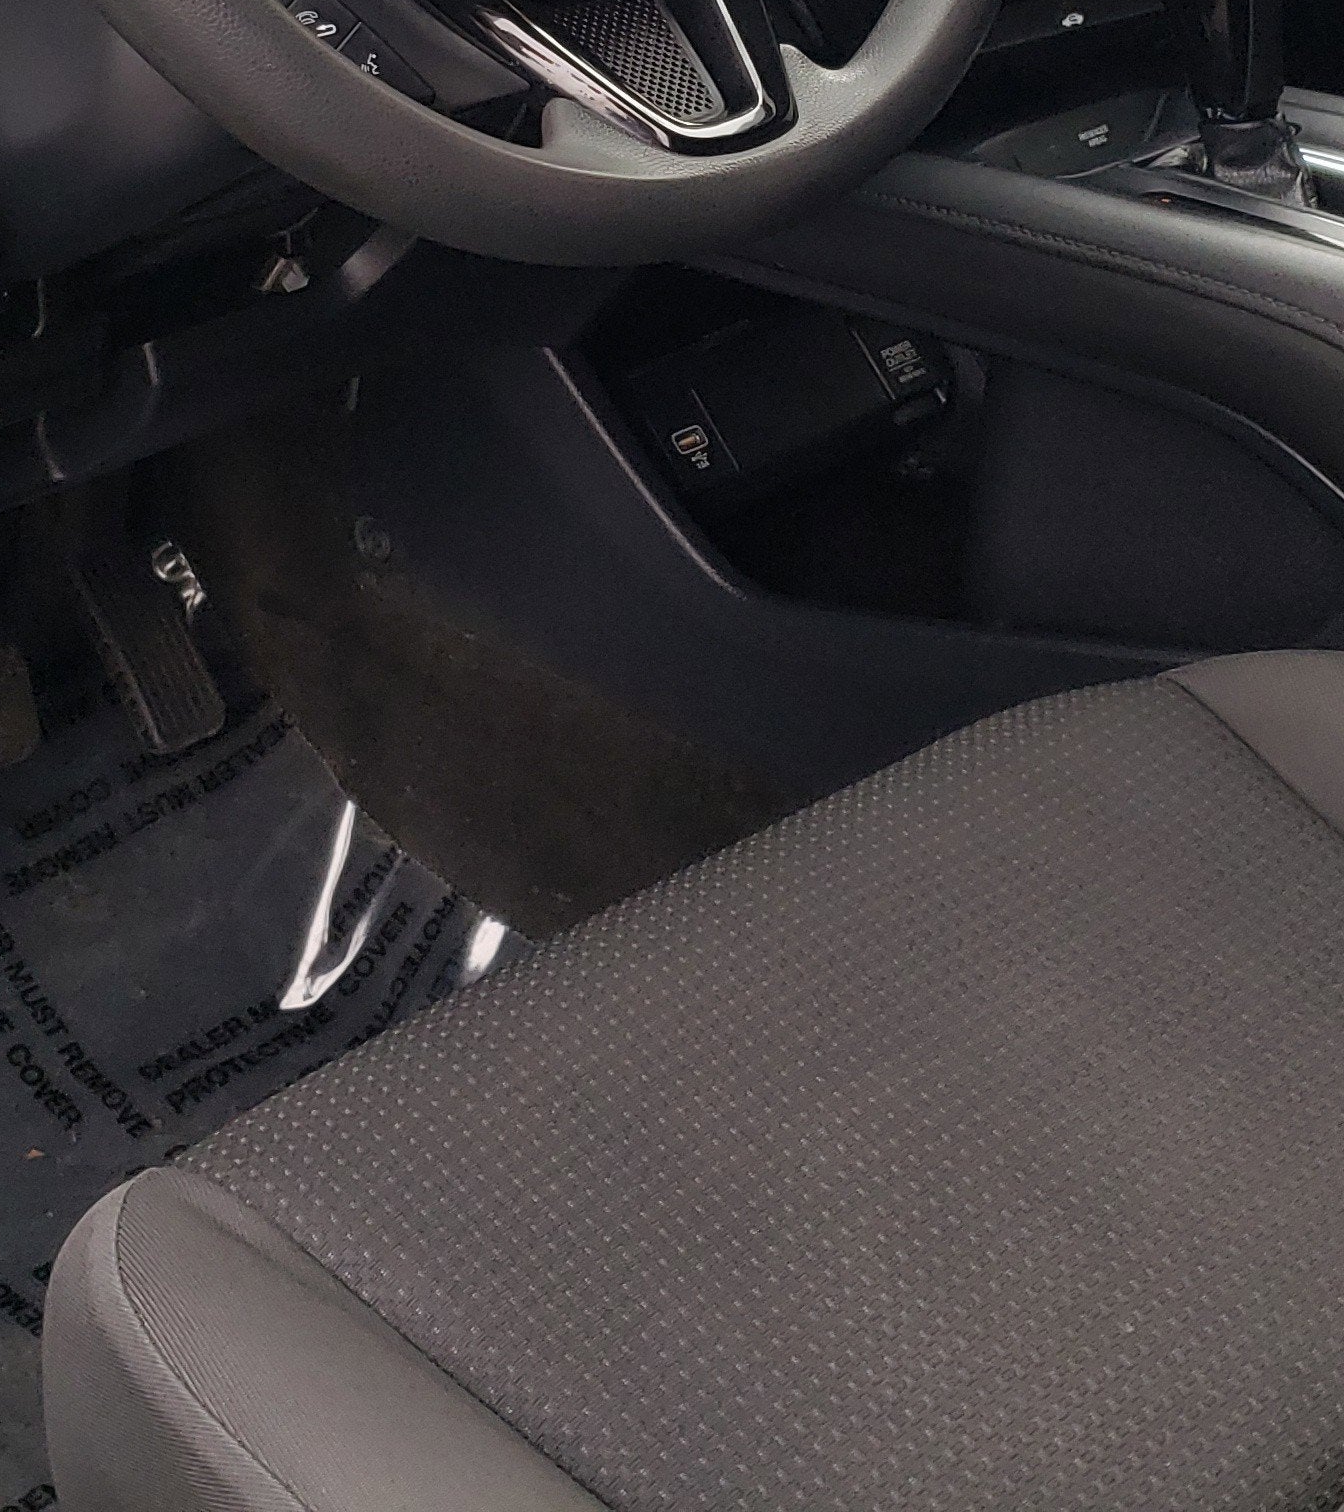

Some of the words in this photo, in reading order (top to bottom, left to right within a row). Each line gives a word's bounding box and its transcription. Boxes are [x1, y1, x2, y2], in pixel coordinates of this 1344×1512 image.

[2, 957, 69, 1041] MUST
[54, 1038, 152, 1140] REMOVE
[135, 1015, 249, 1082] DEALER
[165, 998, 335, 1113] PROTECTIVE
[334, 900, 414, 997] COVER
[4, 1039, 84, 1133] COVER
